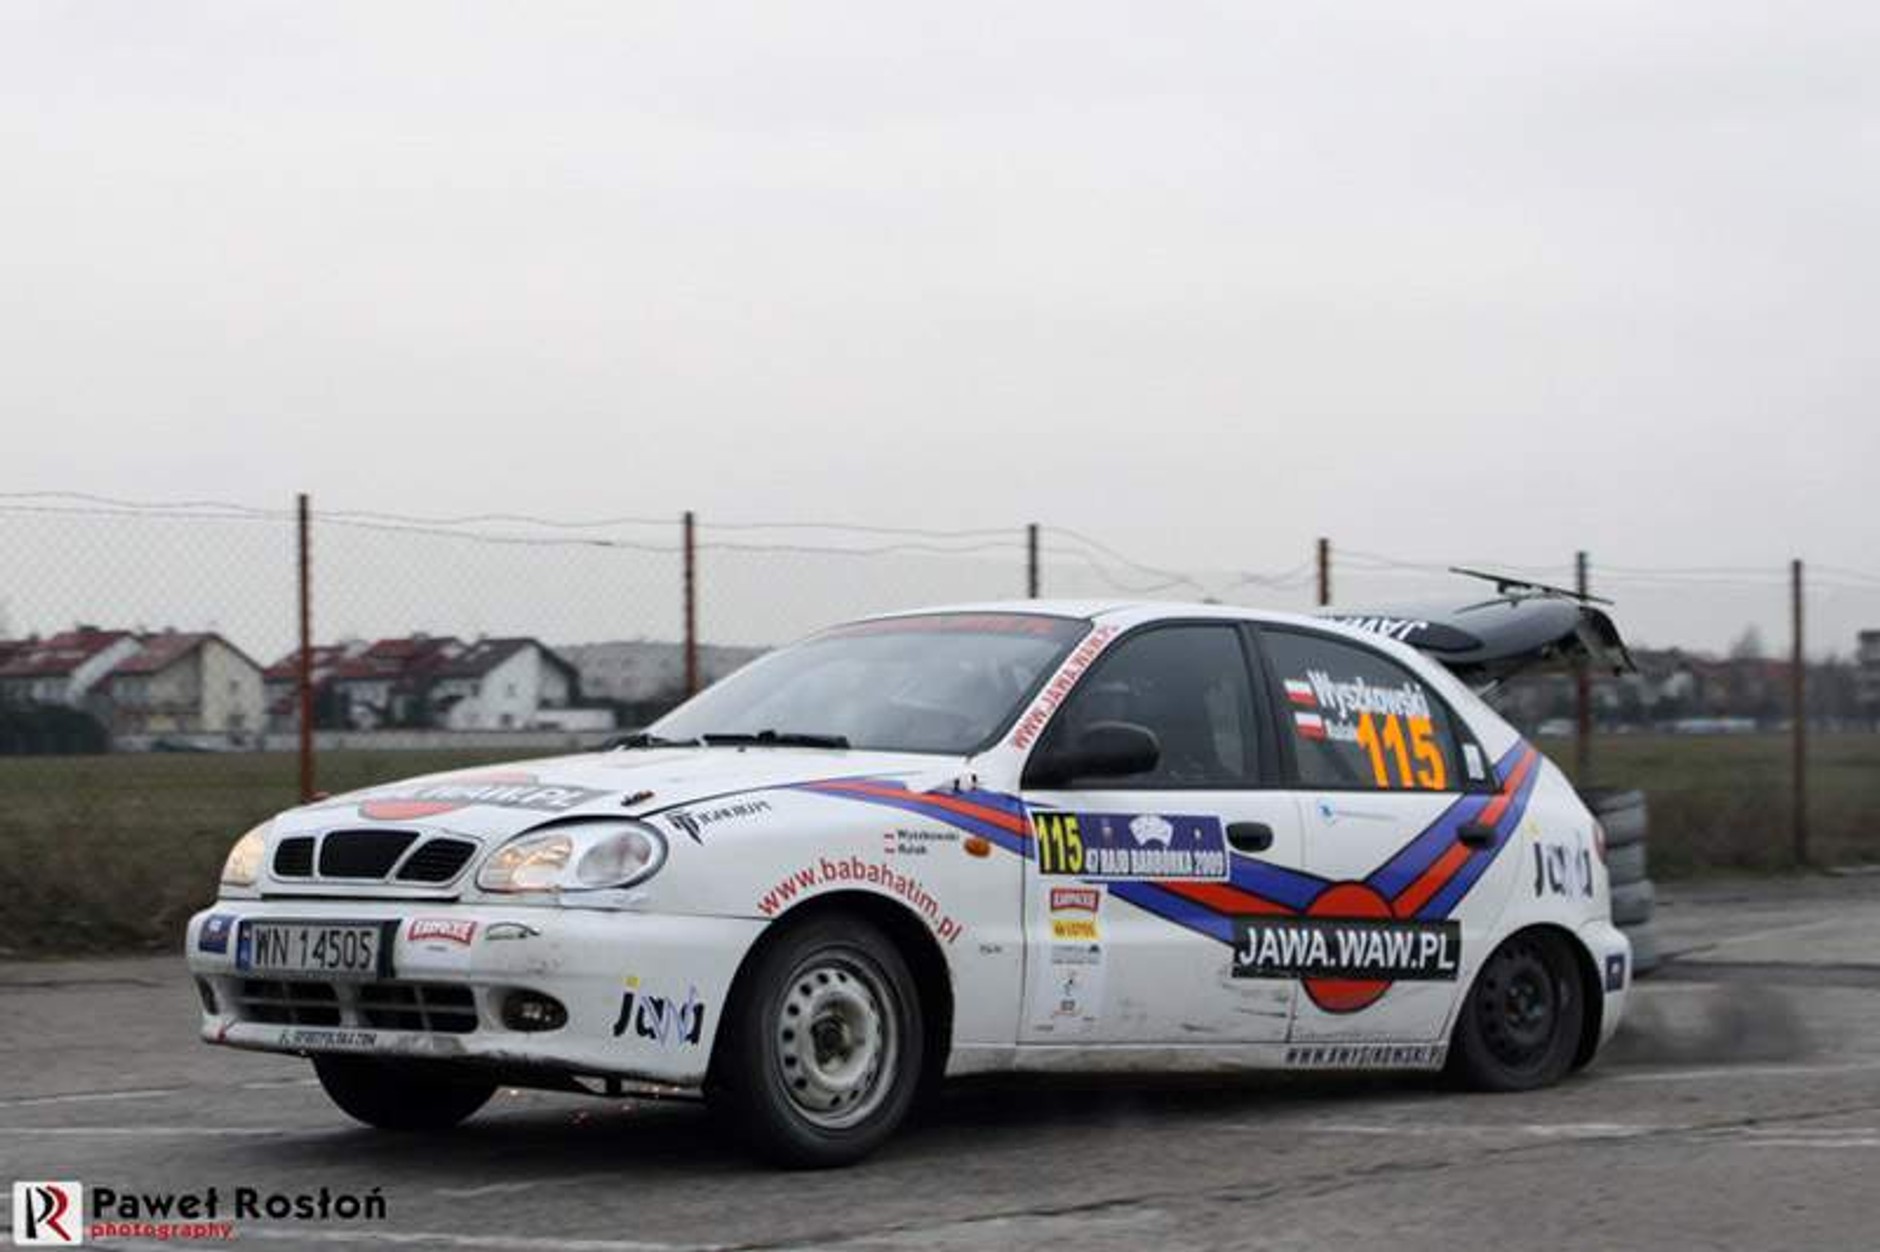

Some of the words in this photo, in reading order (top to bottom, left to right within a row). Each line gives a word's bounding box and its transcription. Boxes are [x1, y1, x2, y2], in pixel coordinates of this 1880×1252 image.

[1306, 669, 1430, 720] Wyszkowski
[1357, 712, 1447, 790] 115
[1037, 814, 1084, 873] 115
[1101, 848, 1130, 873] RAJD
[757, 857, 963, 944] www.babahatim.pl
[254, 928, 289, 966] WN
[299, 930, 372, 969] 14505
[1239, 926, 1456, 970] JAWA.WAW.PL
